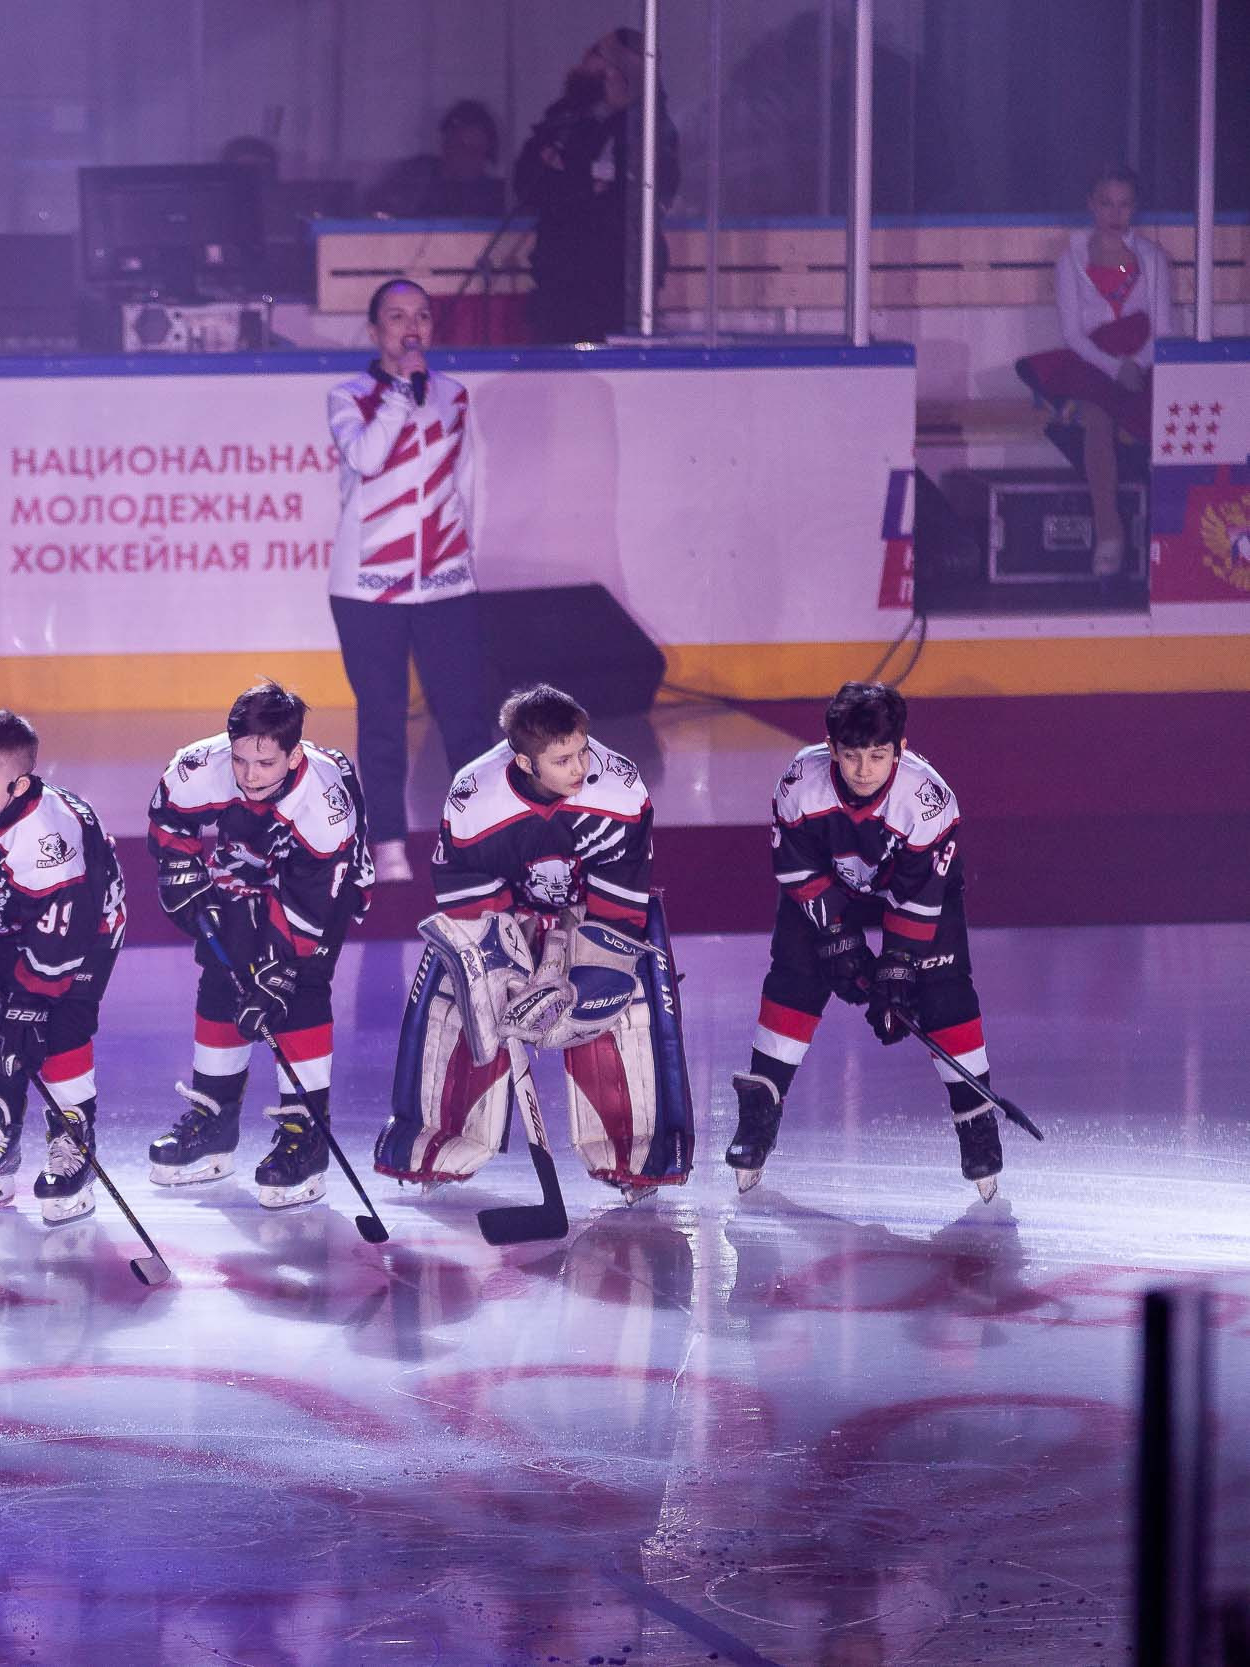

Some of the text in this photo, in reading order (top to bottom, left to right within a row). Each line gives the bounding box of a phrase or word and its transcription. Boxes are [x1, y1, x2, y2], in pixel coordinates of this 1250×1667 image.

[10, 443, 341, 478] НАЦИОНАЛЬНАЯ
[11, 494, 303, 529] МОЛОДЕЖНАЯ
[11, 537, 335, 575] ХОККЕЙНАЯ ЛИГ
